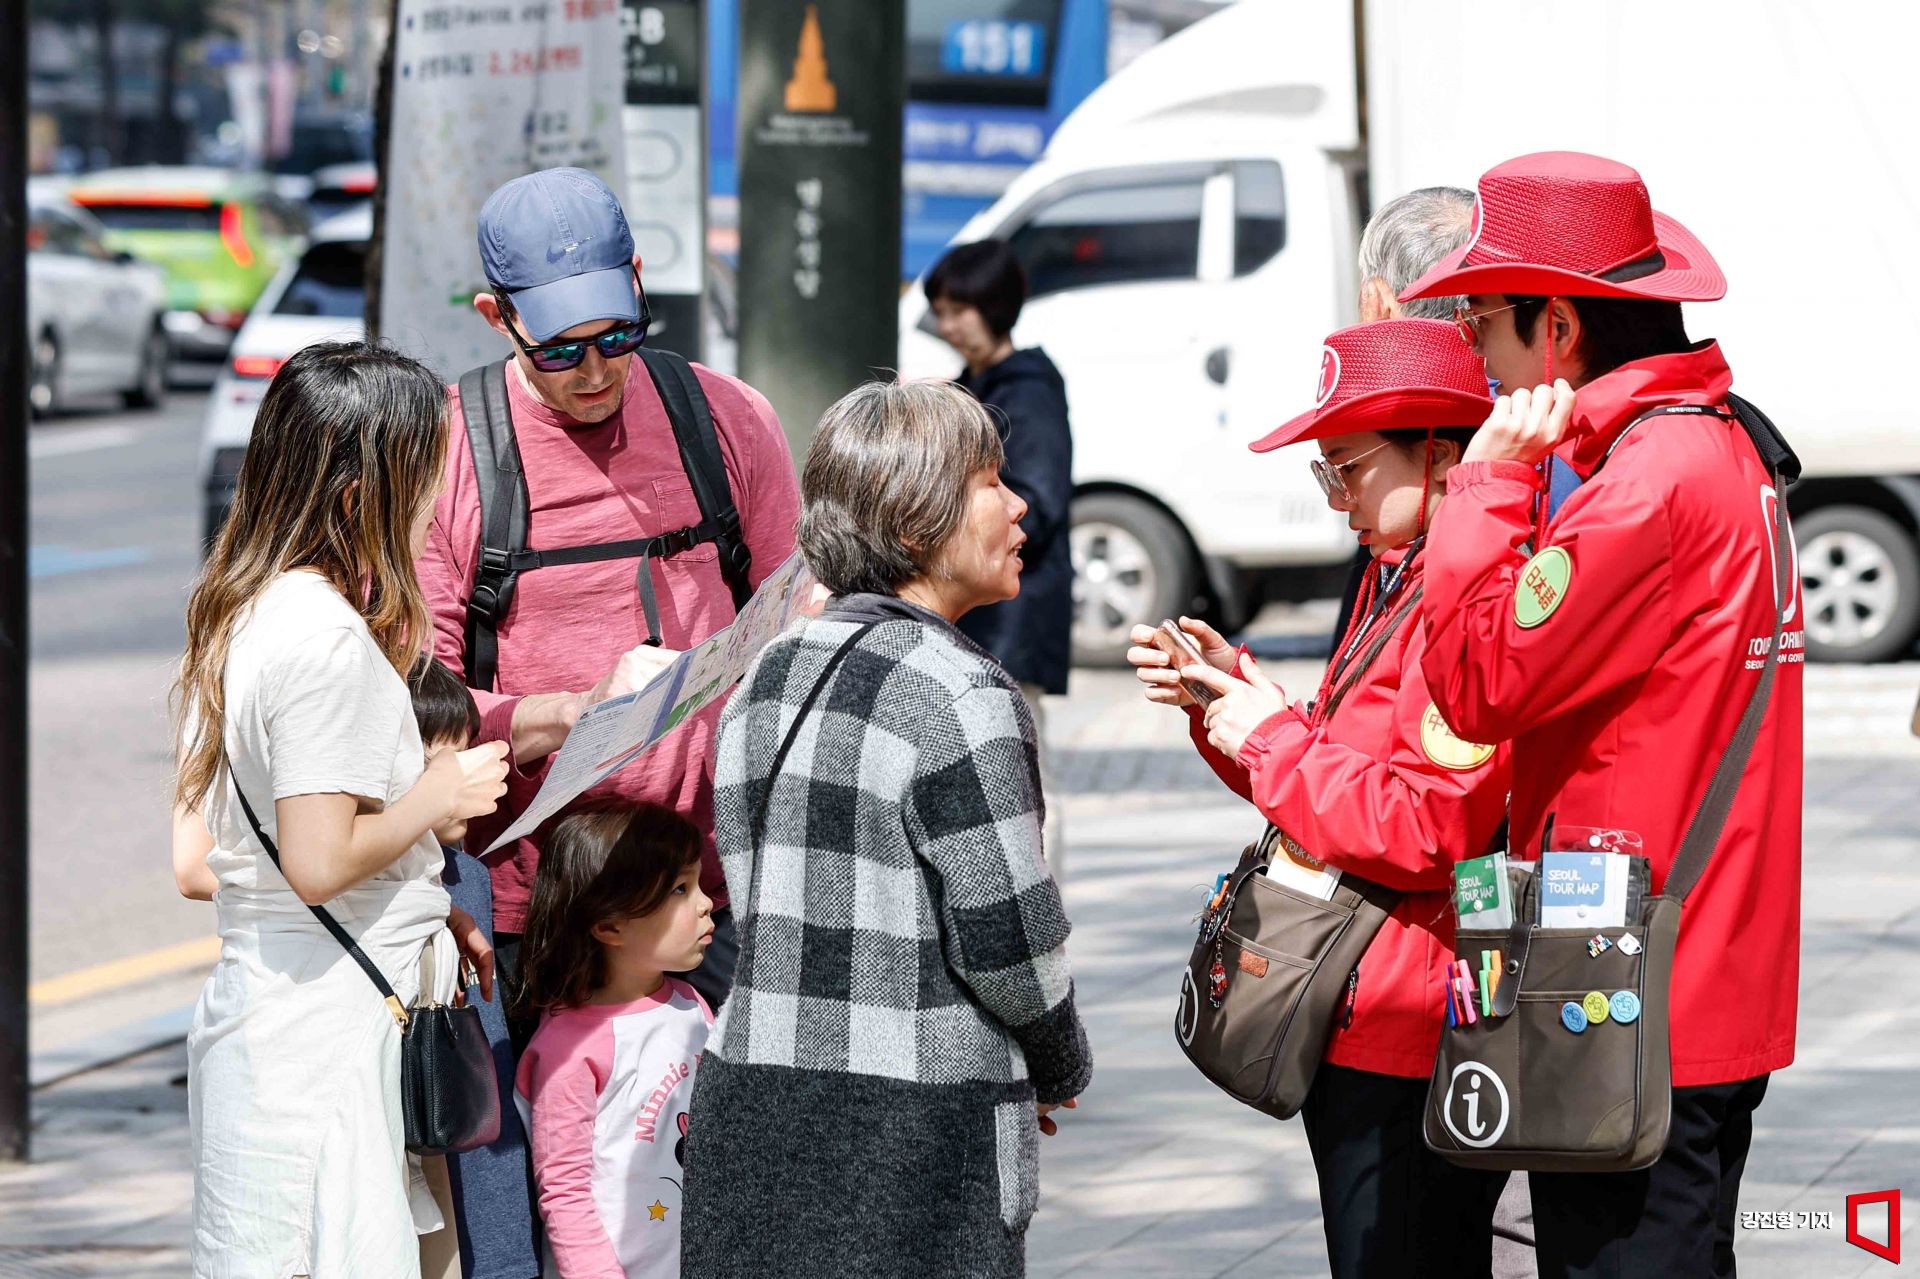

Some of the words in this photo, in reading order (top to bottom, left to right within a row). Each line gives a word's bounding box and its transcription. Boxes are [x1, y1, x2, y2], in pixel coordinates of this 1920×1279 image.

[954, 22, 1032, 72] 151
[1525, 565, 1557, 611] 日本語
[1459, 875, 1482, 890] SEOUL
[1547, 869, 1581, 881] SEOUL
[1460, 889, 1480, 903] TOUR
[1547, 882, 1575, 895] TOUR
[1577, 882, 1600, 895] MAP
[635, 1062, 689, 1143] Minnie
